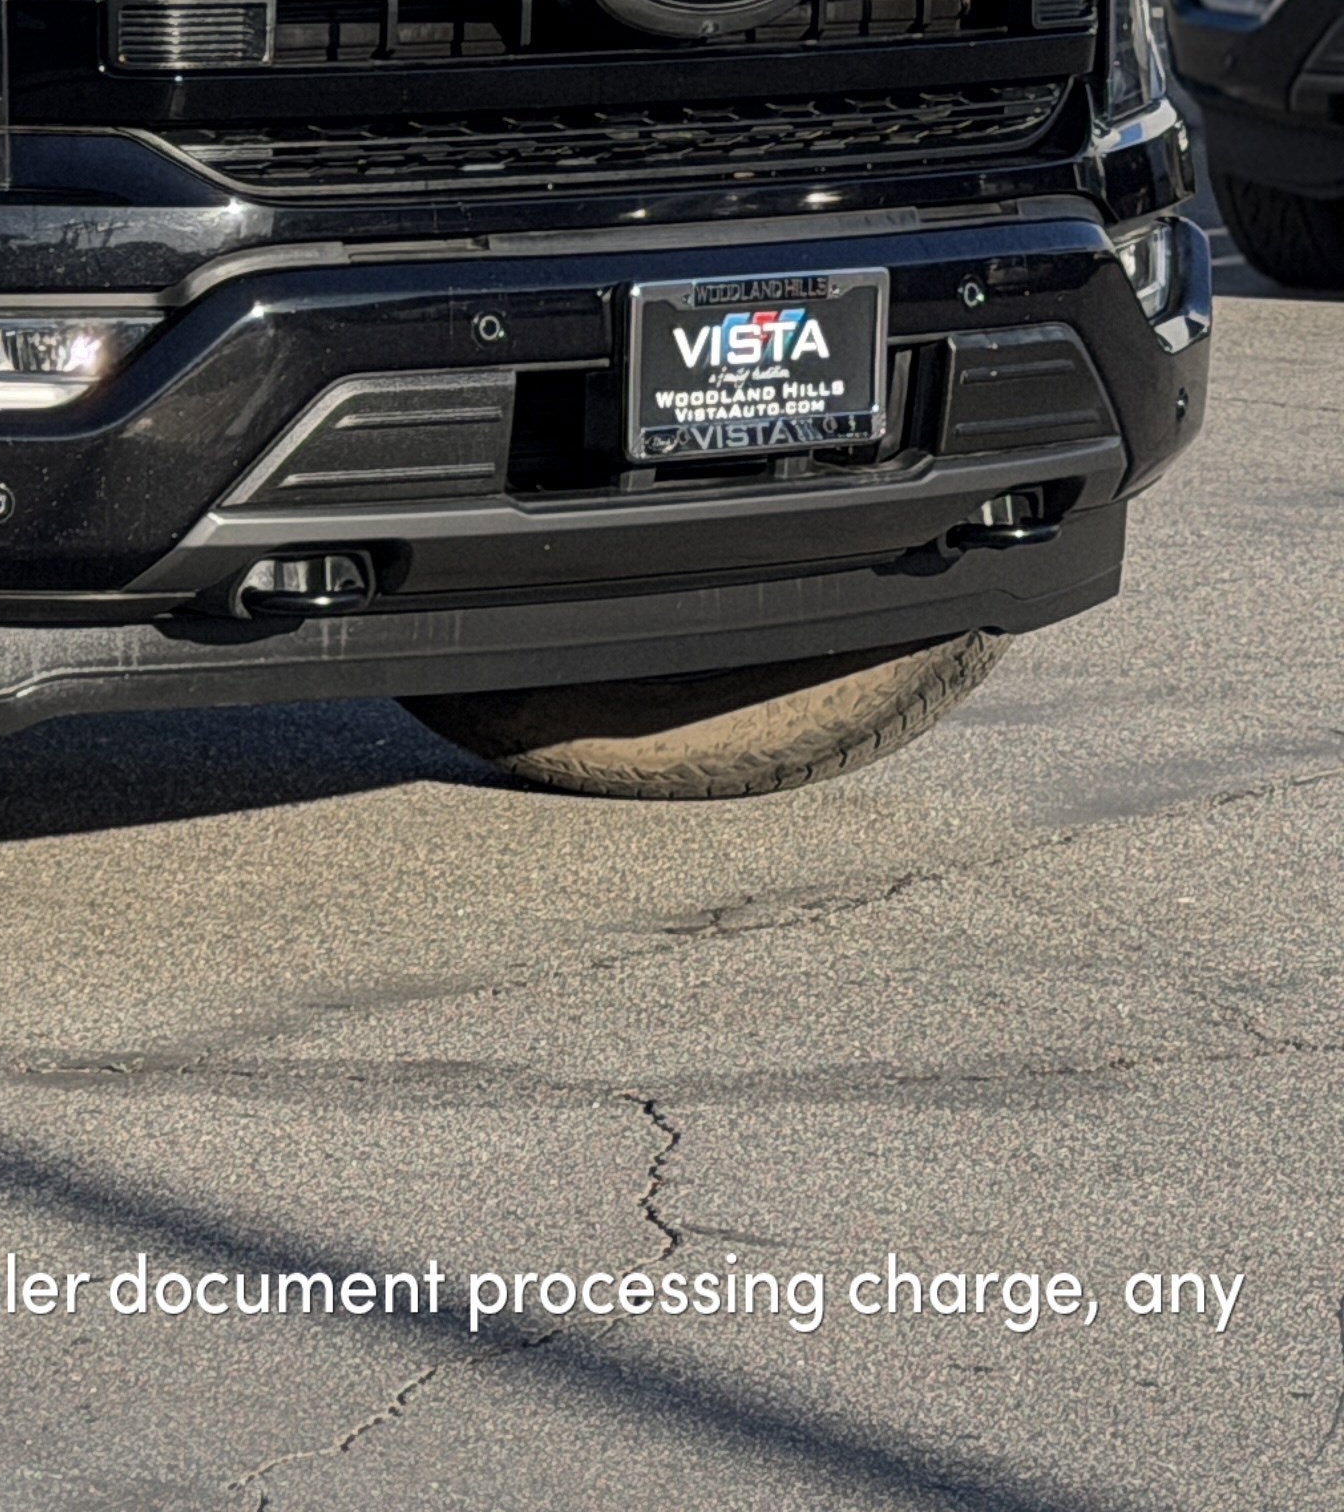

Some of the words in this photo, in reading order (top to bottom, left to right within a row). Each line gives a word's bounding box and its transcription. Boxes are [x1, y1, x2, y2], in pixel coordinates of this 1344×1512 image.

[695, 281, 782, 304] WOODLAND
[784, 277, 829, 299] HILLS
[673, 319, 830, 369] VISTA
[655, 386, 776, 409] WOODLAND
[783, 380, 845, 399] HILLS
[691, 419, 794, 450] VISTA
